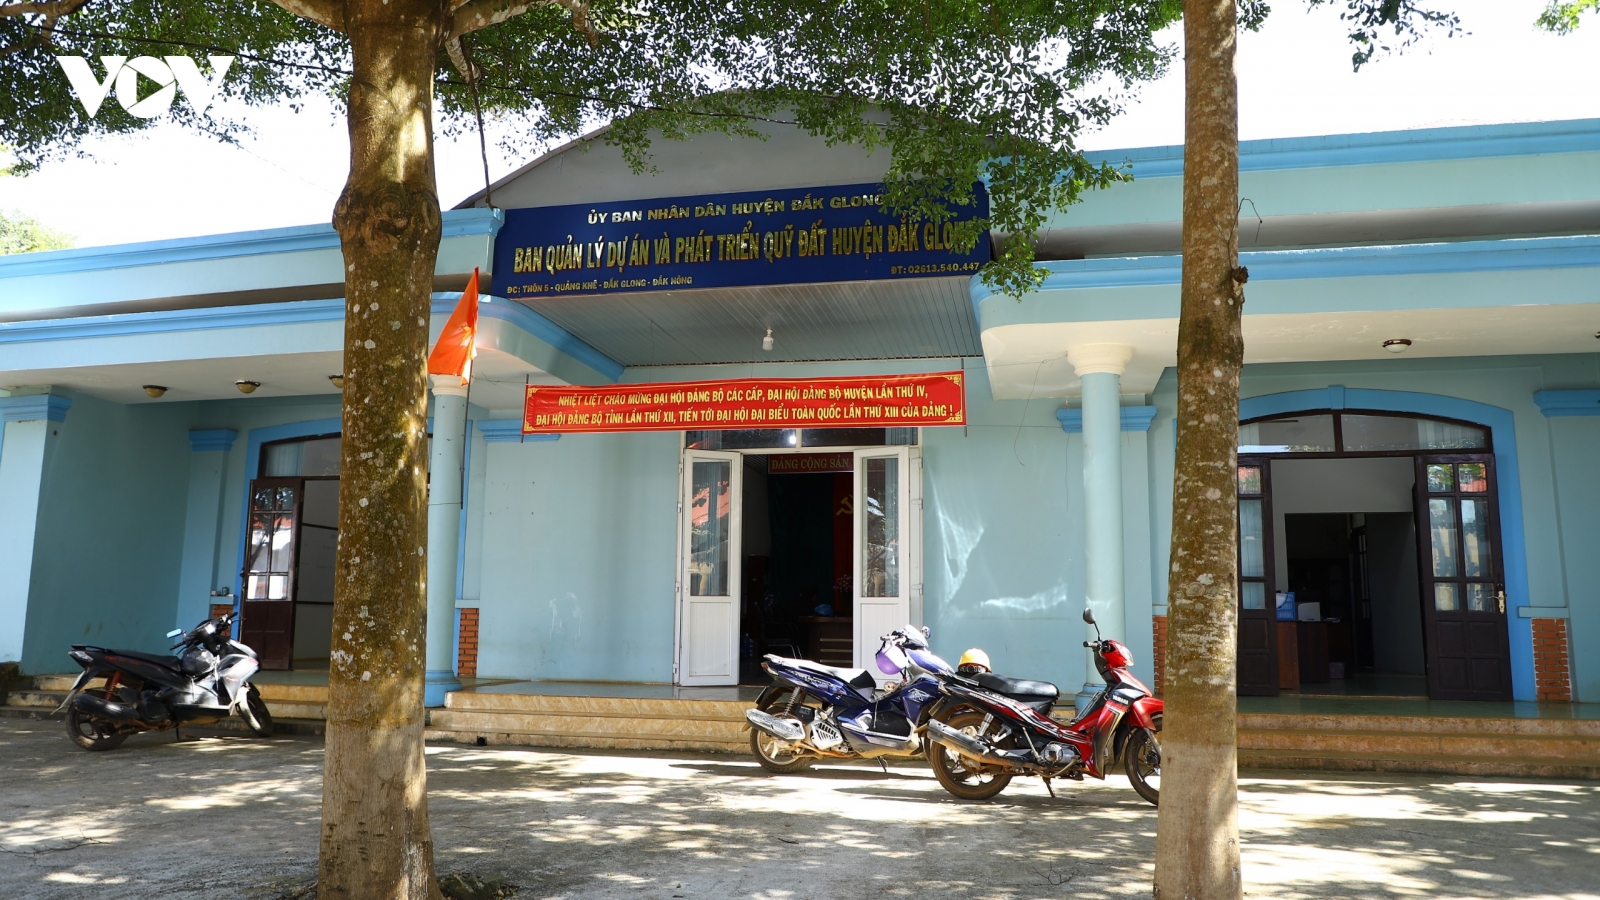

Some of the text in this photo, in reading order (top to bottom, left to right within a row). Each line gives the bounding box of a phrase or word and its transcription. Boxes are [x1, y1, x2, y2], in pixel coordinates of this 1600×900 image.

[588, 209, 608, 225] ỦY
[612, 210, 642, 223] BAN
[648, 205, 690, 220] NHÂN
[694, 202, 726, 217] DÂN
[732, 198, 785, 216] HUYỆN
[791, 193, 824, 211] ĐẮK
[514, 212, 976, 275] BAN QUẢN LÝ DỰ ÁN VÀ PHÁT TRIỂN QUỸ ĐẤT HUYỆN ĐẮK GLO
[523, 283, 542, 293] THÔN
[544, 284, 549, 292] 5
[621, 279, 646, 288] GLONG
[671, 275, 692, 285] NÔNG
[558, 382, 928, 408] NHIỆT LIỆT CHÀO MỪNG ĐẠI HỘI ĐẢNG BỘ CÁC CẤP, ĐẠI HỘI ĐẢNG BỘ HUYỆN LẦN THỨ IV,
[536, 414, 549, 427] ĐẠI
[552, 411, 566, 427] HỘI
[568, 410, 590, 425] ĐẢNG
[591, 411, 603, 426] BỘ
[605, 409, 623, 424] TỈNH
[626, 408, 642, 423] LẦN
[644, 409, 661, 423] THỨ
[663, 411, 676, 424] XII,
[679, 406, 698, 422] TIẾN
[701, 407, 714, 421] TỚI
[717, 409, 731, 423] ĐẠI
[734, 406, 748, 422] HỘI
[751, 409, 765, 422] ĐẠI
[768, 403, 789, 420] BIỂU
[792, 405, 815, 420] TOÀN
[817, 403, 841, 421] QUỐC
[844, 402, 861, 418] LẦN
[864, 404, 882, 418] THỨ
[884, 406, 899, 418] XIII
[901, 402, 919, 417] CỦA
[922, 401, 947, 417] ĐẢNG
[772, 456, 798, 470] ĐẢNG
[800, 457, 827, 471] CỘNG
[830, 455, 849, 468] SẢN
